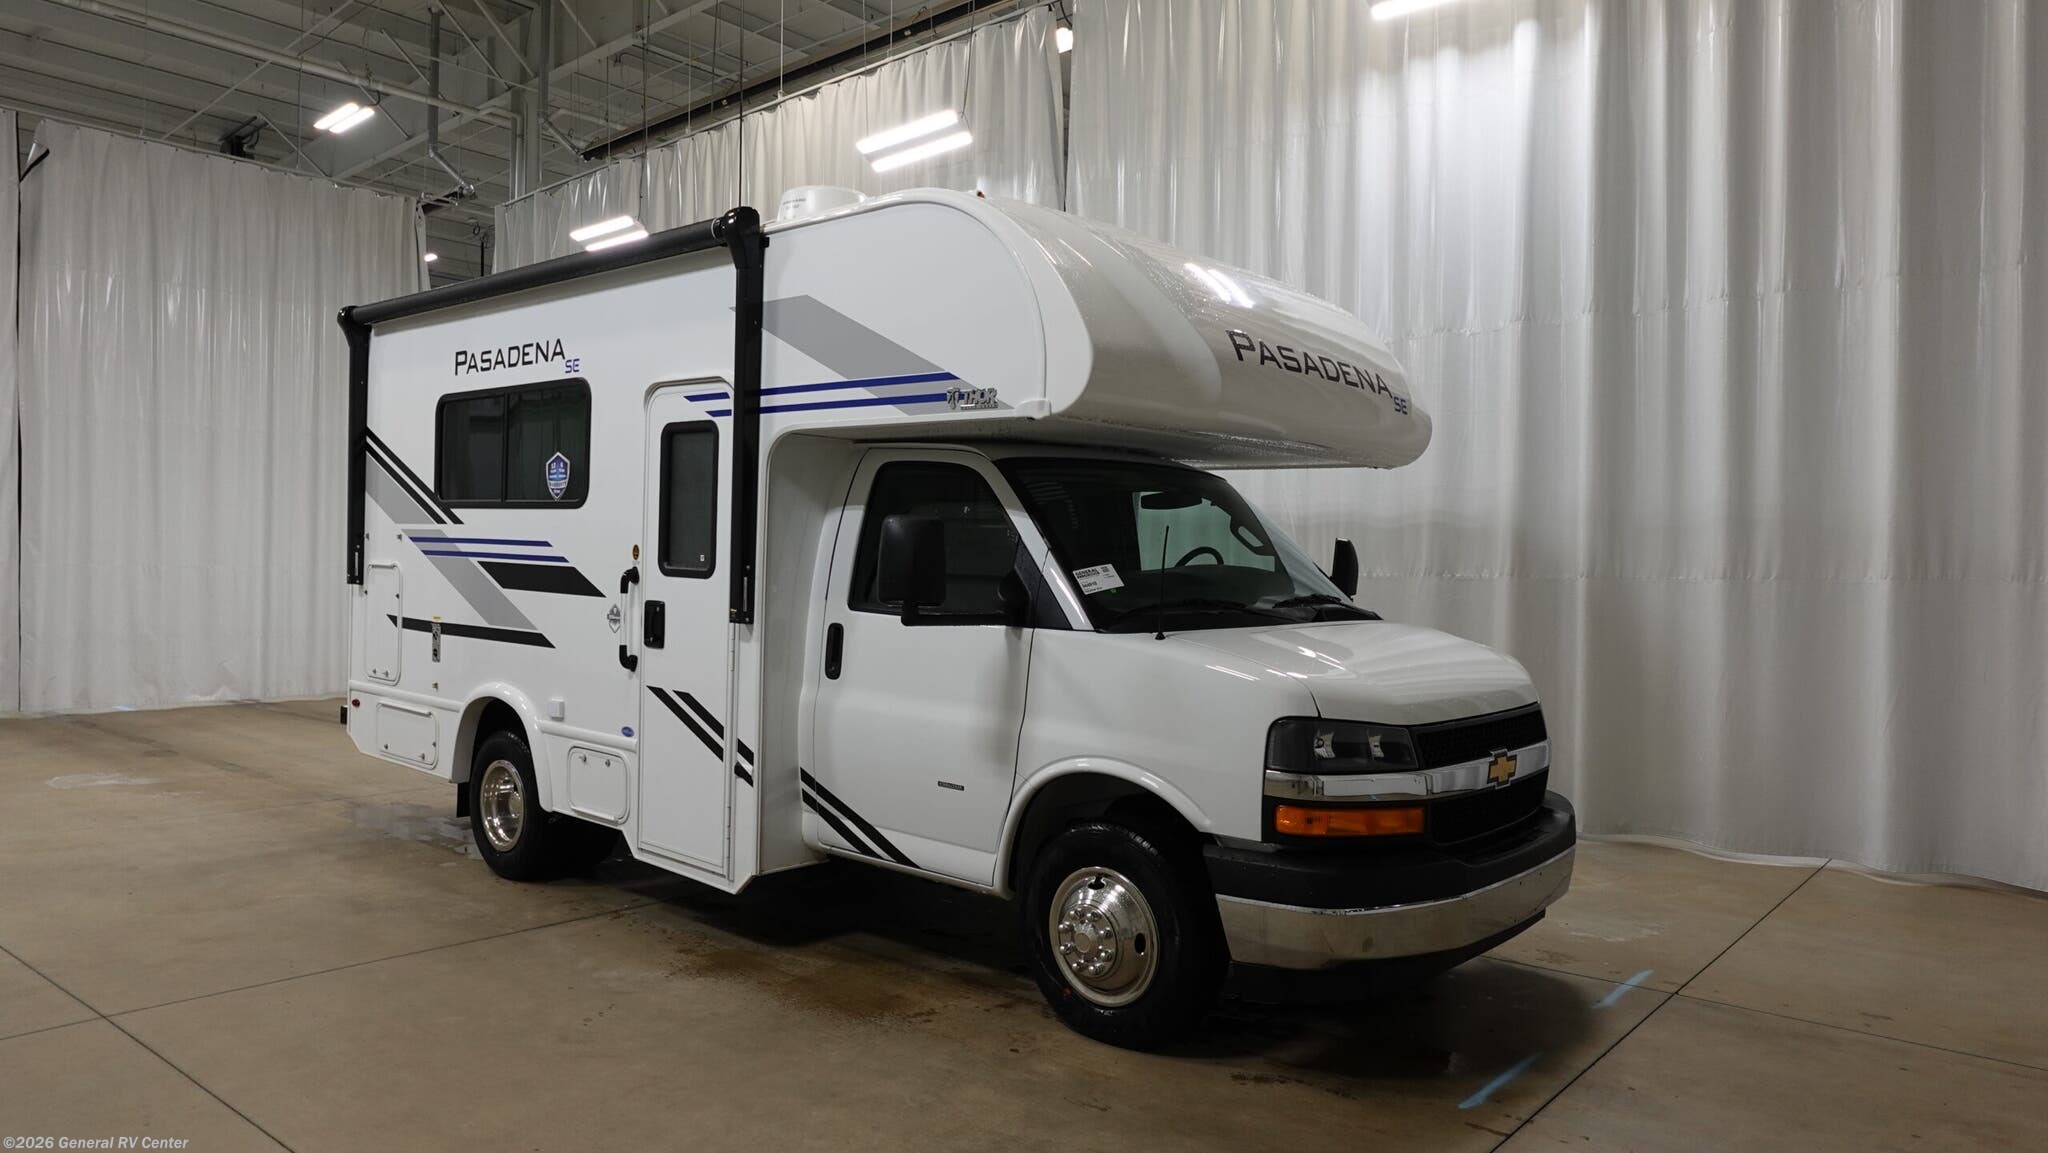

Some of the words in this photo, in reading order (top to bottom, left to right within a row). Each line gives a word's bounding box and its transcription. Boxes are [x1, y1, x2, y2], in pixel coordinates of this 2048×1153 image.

[455, 338, 565, 376] PASADENA
[565, 358, 580, 374] SE
[1225, 329, 1393, 399] PASADENA
[1393, 396, 1408, 415] SE
[959, 387, 998, 405] THOR
